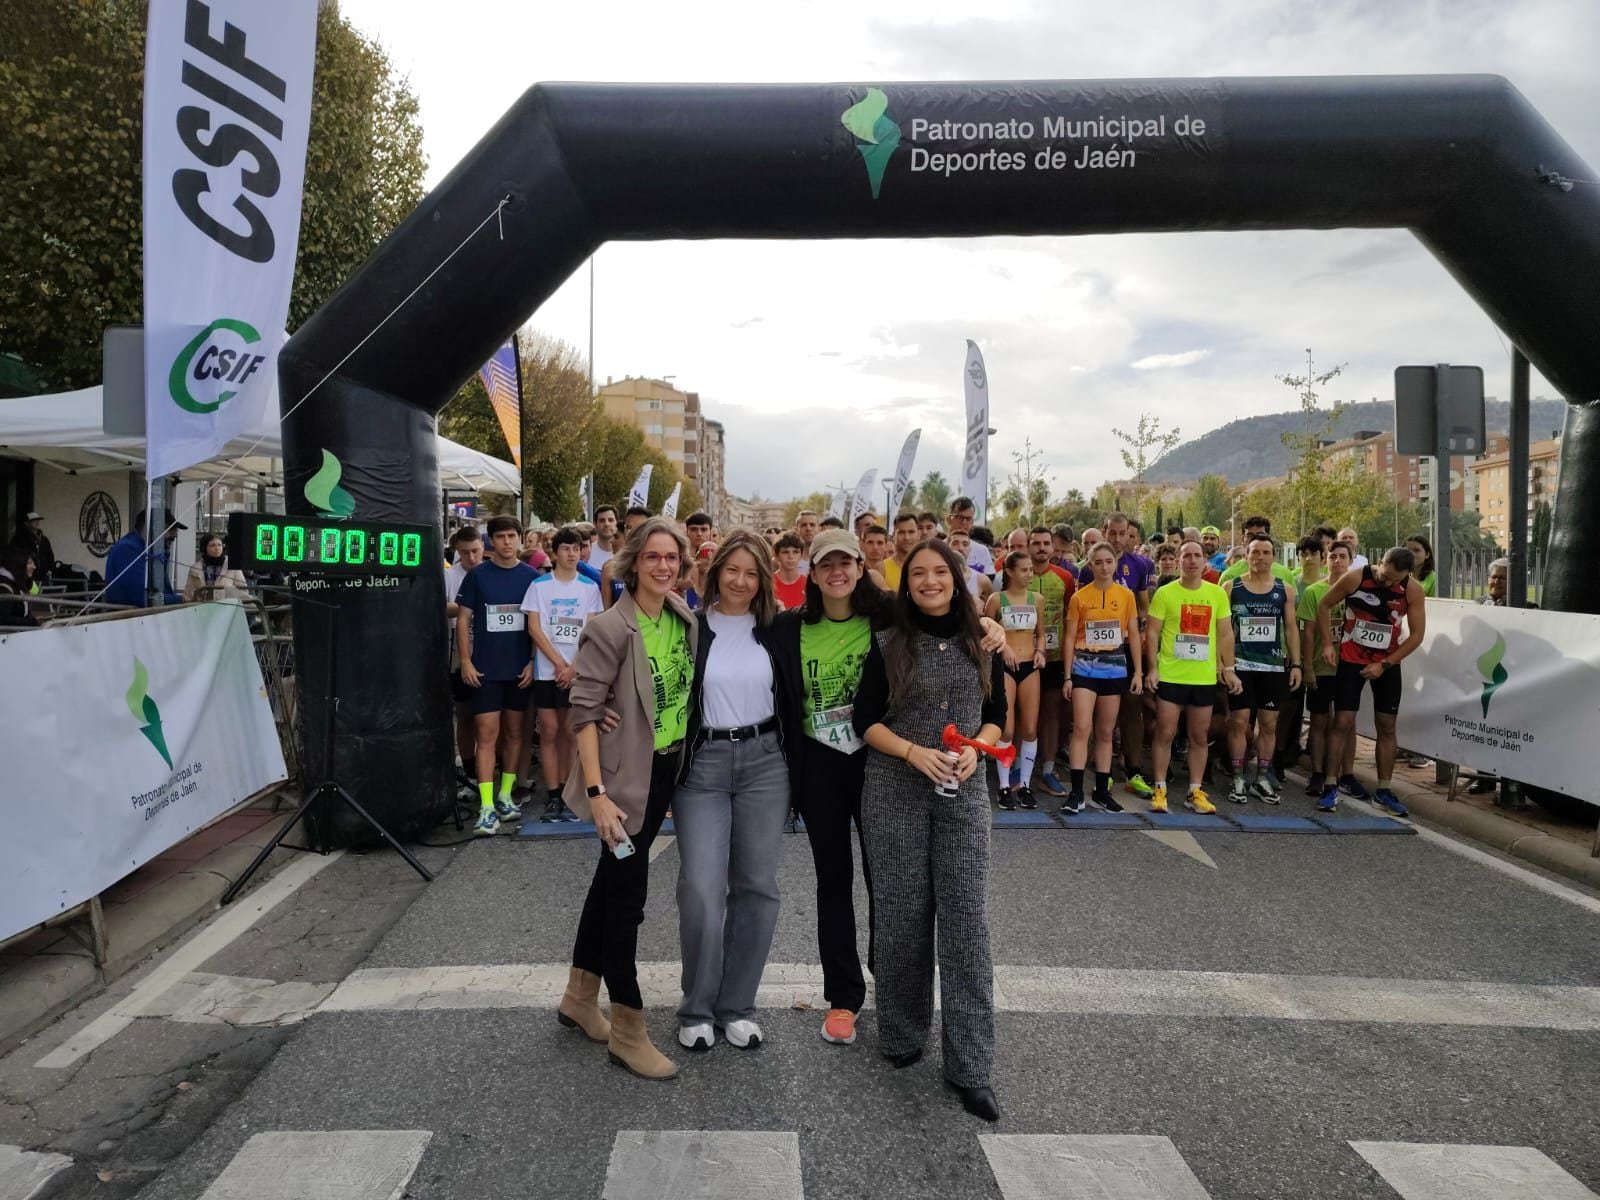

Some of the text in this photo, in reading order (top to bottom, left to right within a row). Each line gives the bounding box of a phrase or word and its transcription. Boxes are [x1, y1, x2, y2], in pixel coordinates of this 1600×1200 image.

[172, 0, 287, 263] CSIF
[911, 114, 1206, 143] Patronato Municipal de
[910, 143, 1137, 177] Deportes de Jaén
[193, 344, 266, 385] CSIF
[366, 575, 400, 588] Jaén
[498, 614, 515, 625] 99
[1010, 613, 1031, 625] 177
[555, 625, 578, 638] 285
[1093, 629, 1115, 641] 350
[1247, 626, 1270, 636] 240
[1360, 630, 1384, 643] 200
[1189, 644, 1197, 654] 5
[806, 658, 819, 679] 17
[828, 724, 852, 745] 41
[1444, 714, 1535, 743] Patronato Municipal de
[1451, 727, 1521, 753] Deportes de Jaén
[193, 760, 203, 774] de
[170, 790, 180, 803] de
[180, 780, 198, 798] Jaén
